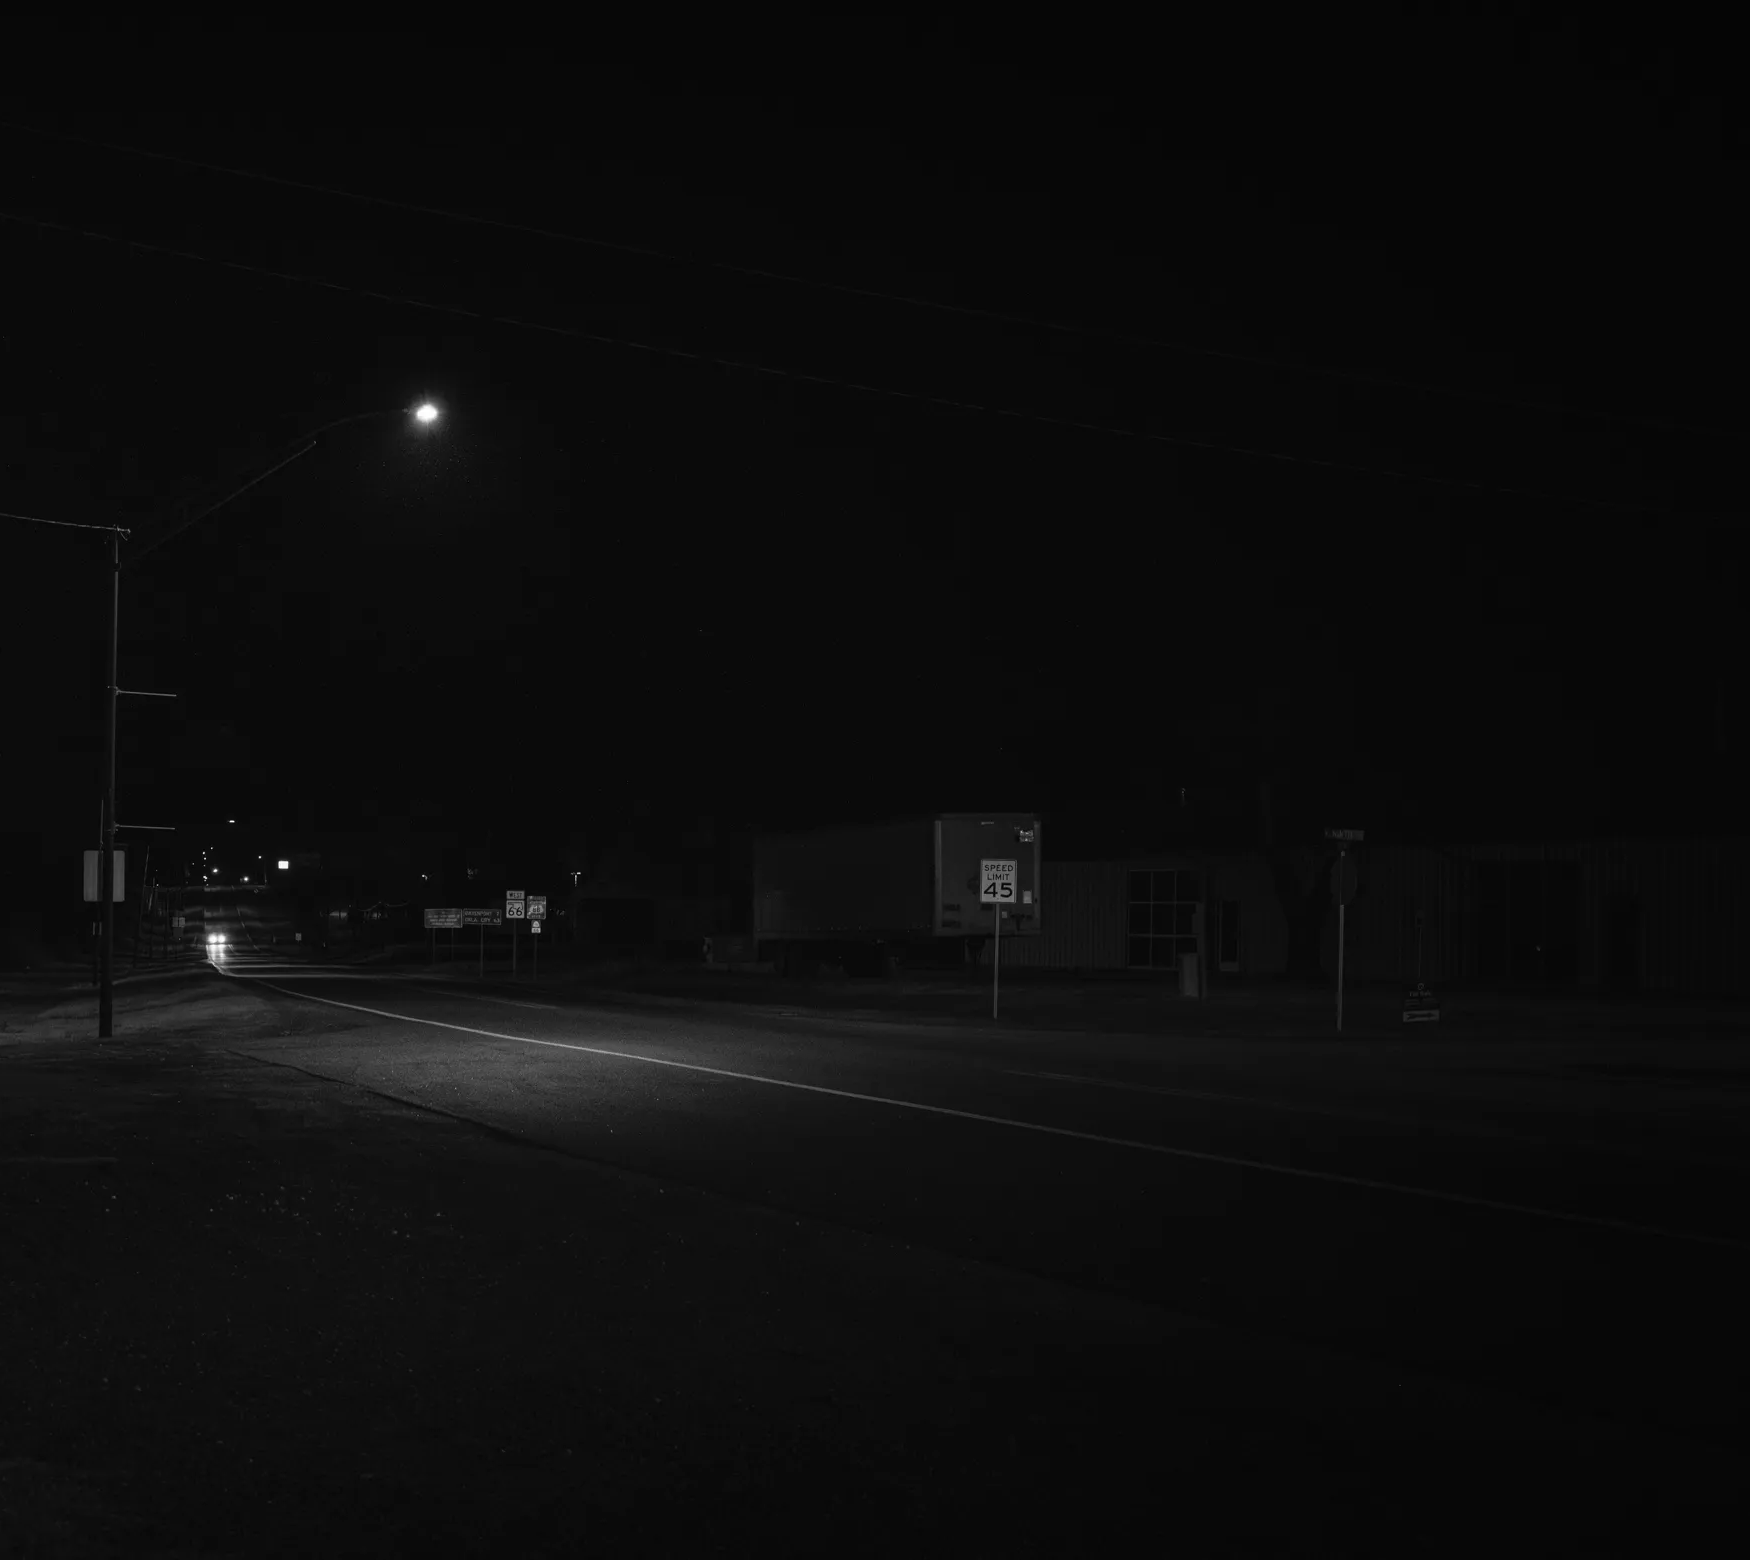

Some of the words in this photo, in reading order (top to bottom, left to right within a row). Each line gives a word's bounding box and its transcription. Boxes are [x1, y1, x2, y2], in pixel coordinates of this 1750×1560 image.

[984, 864, 1014, 872] SPEED
[987, 873, 1010, 881] LIMIT
[983, 882, 1013, 898] 45
[508, 906, 523, 917] 66
